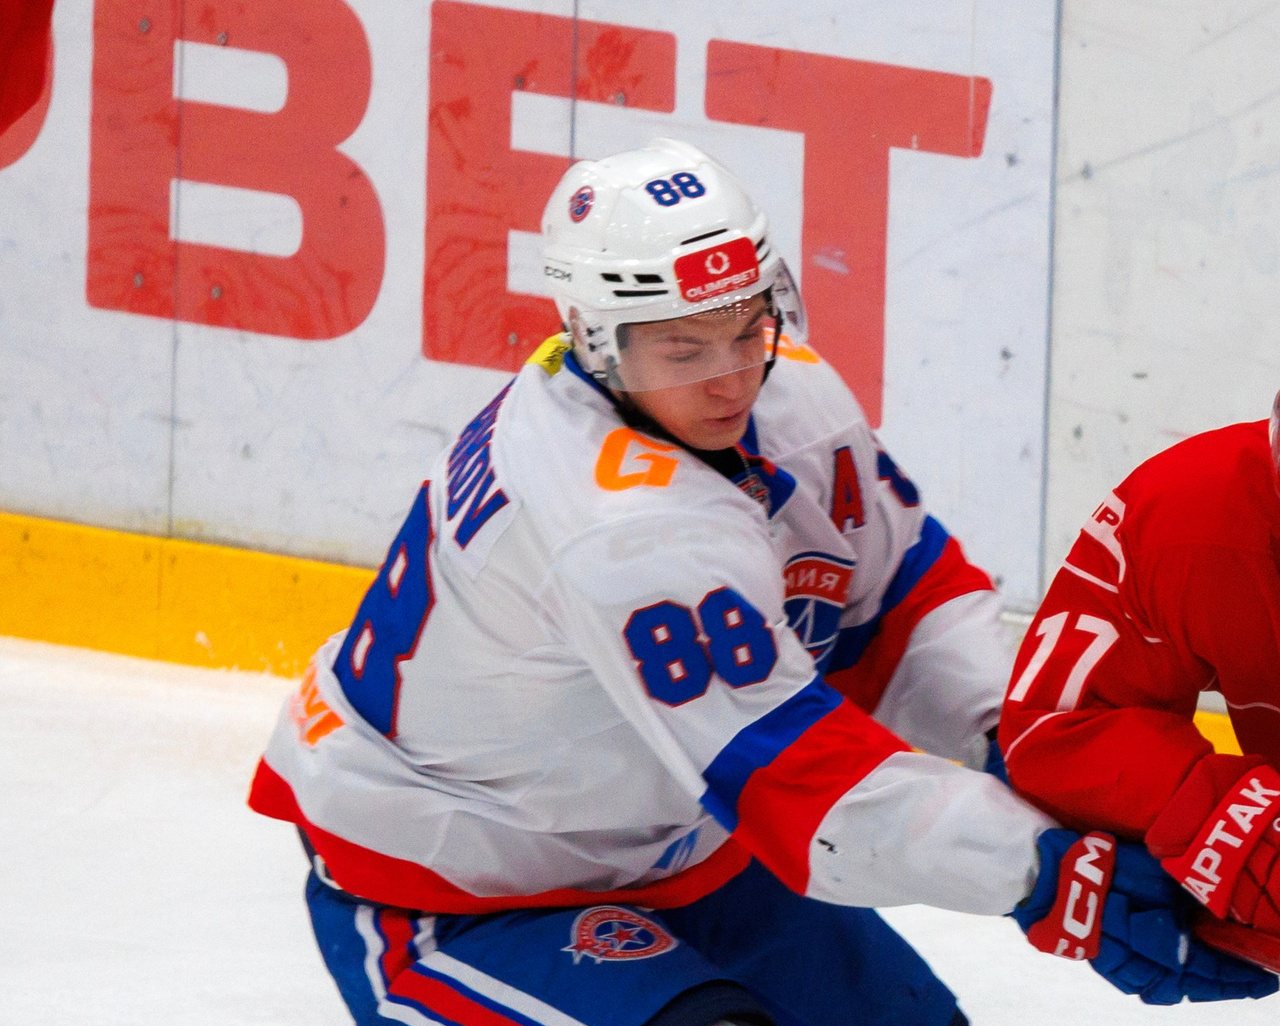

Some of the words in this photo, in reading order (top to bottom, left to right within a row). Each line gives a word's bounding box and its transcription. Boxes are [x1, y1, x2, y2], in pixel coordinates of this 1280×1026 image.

[0, 0, 992, 430] BET
[645, 171, 706, 207] 88
[544, 265, 572, 283] CCM
[686, 267, 756, 299] OLIMPBET
[830, 445, 866, 534] A
[333, 480, 437, 739] 8
[622, 585, 779, 709] 88
[1008, 610, 1121, 713] 17
